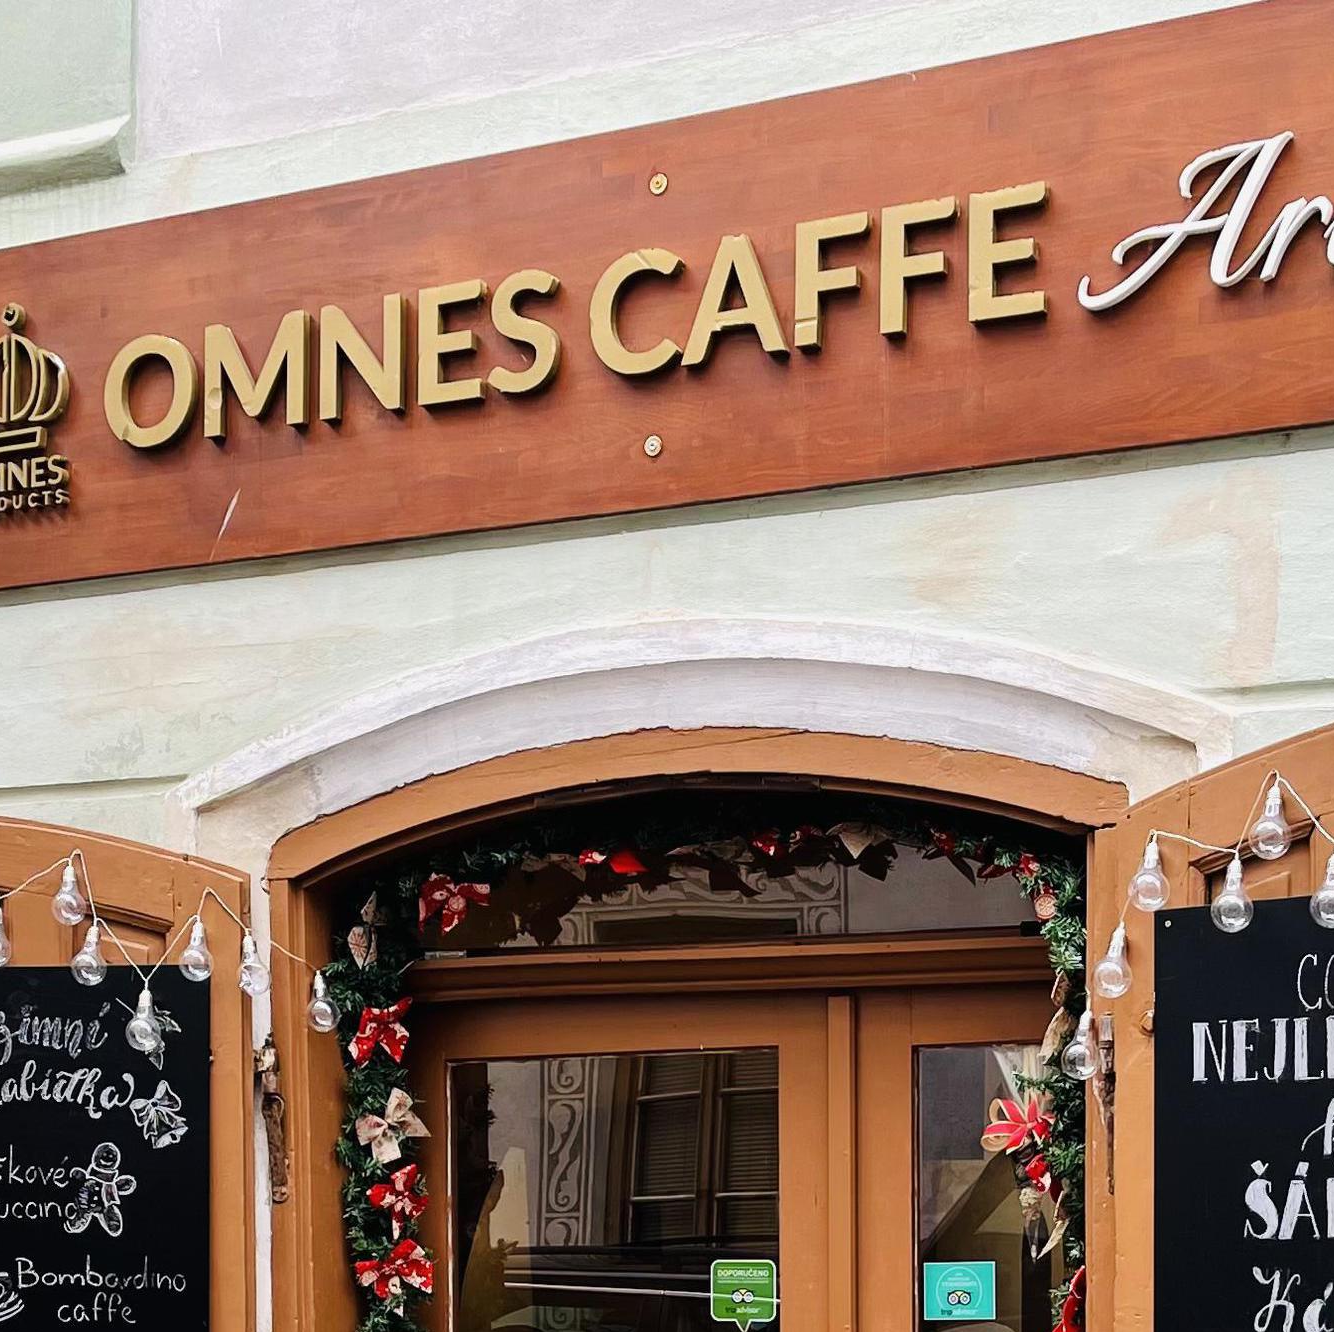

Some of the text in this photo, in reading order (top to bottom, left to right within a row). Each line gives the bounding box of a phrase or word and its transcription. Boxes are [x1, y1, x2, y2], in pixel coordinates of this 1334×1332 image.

[104, 268, 563, 451] OMNES
[590, 180, 1051, 378] CAFFE
[15, 1254, 187, 1292] Bombardino
[57, 1291, 137, 1323] caffe
